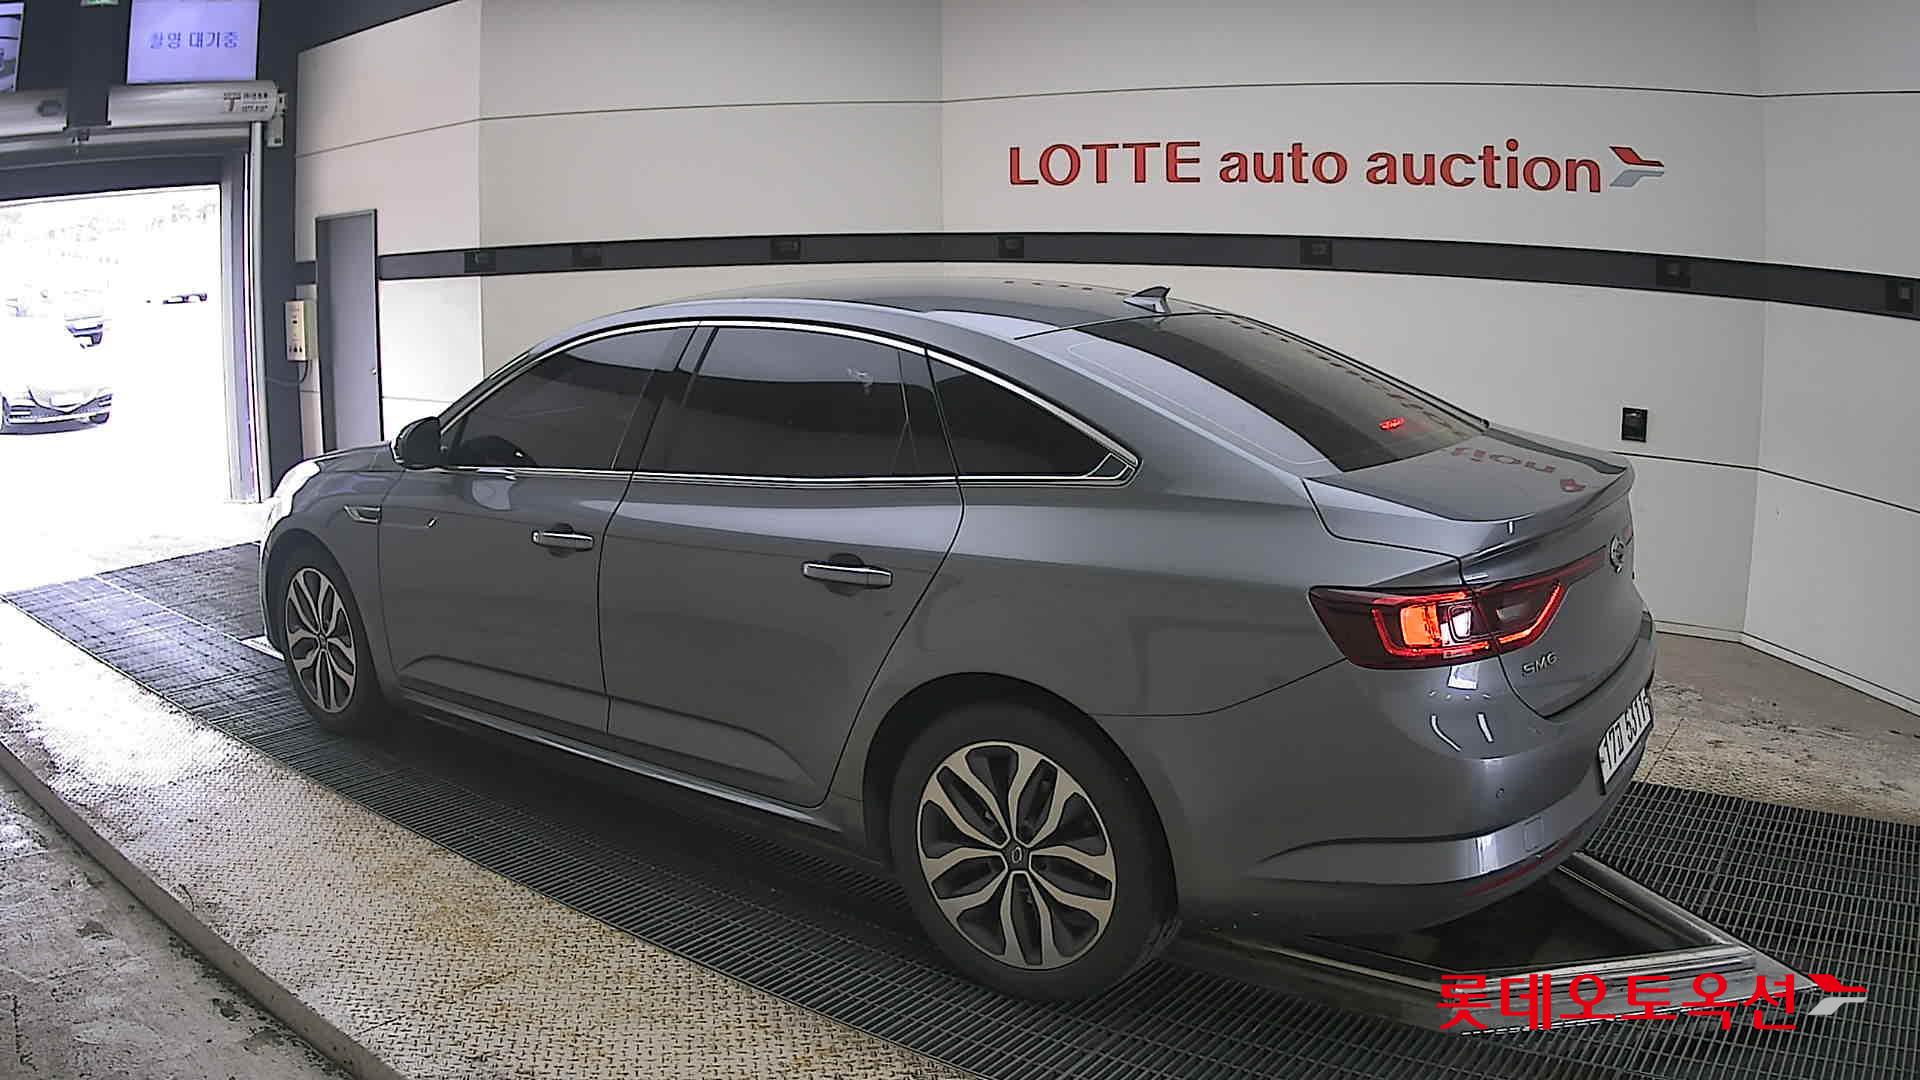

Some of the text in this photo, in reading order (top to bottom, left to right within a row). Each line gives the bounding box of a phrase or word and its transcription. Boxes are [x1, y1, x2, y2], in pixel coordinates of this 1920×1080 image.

[189, 31, 240, 48] 대기중
[1008, 138, 1601, 193] LOTTE auto auction
[1522, 651, 1557, 673] SM6
